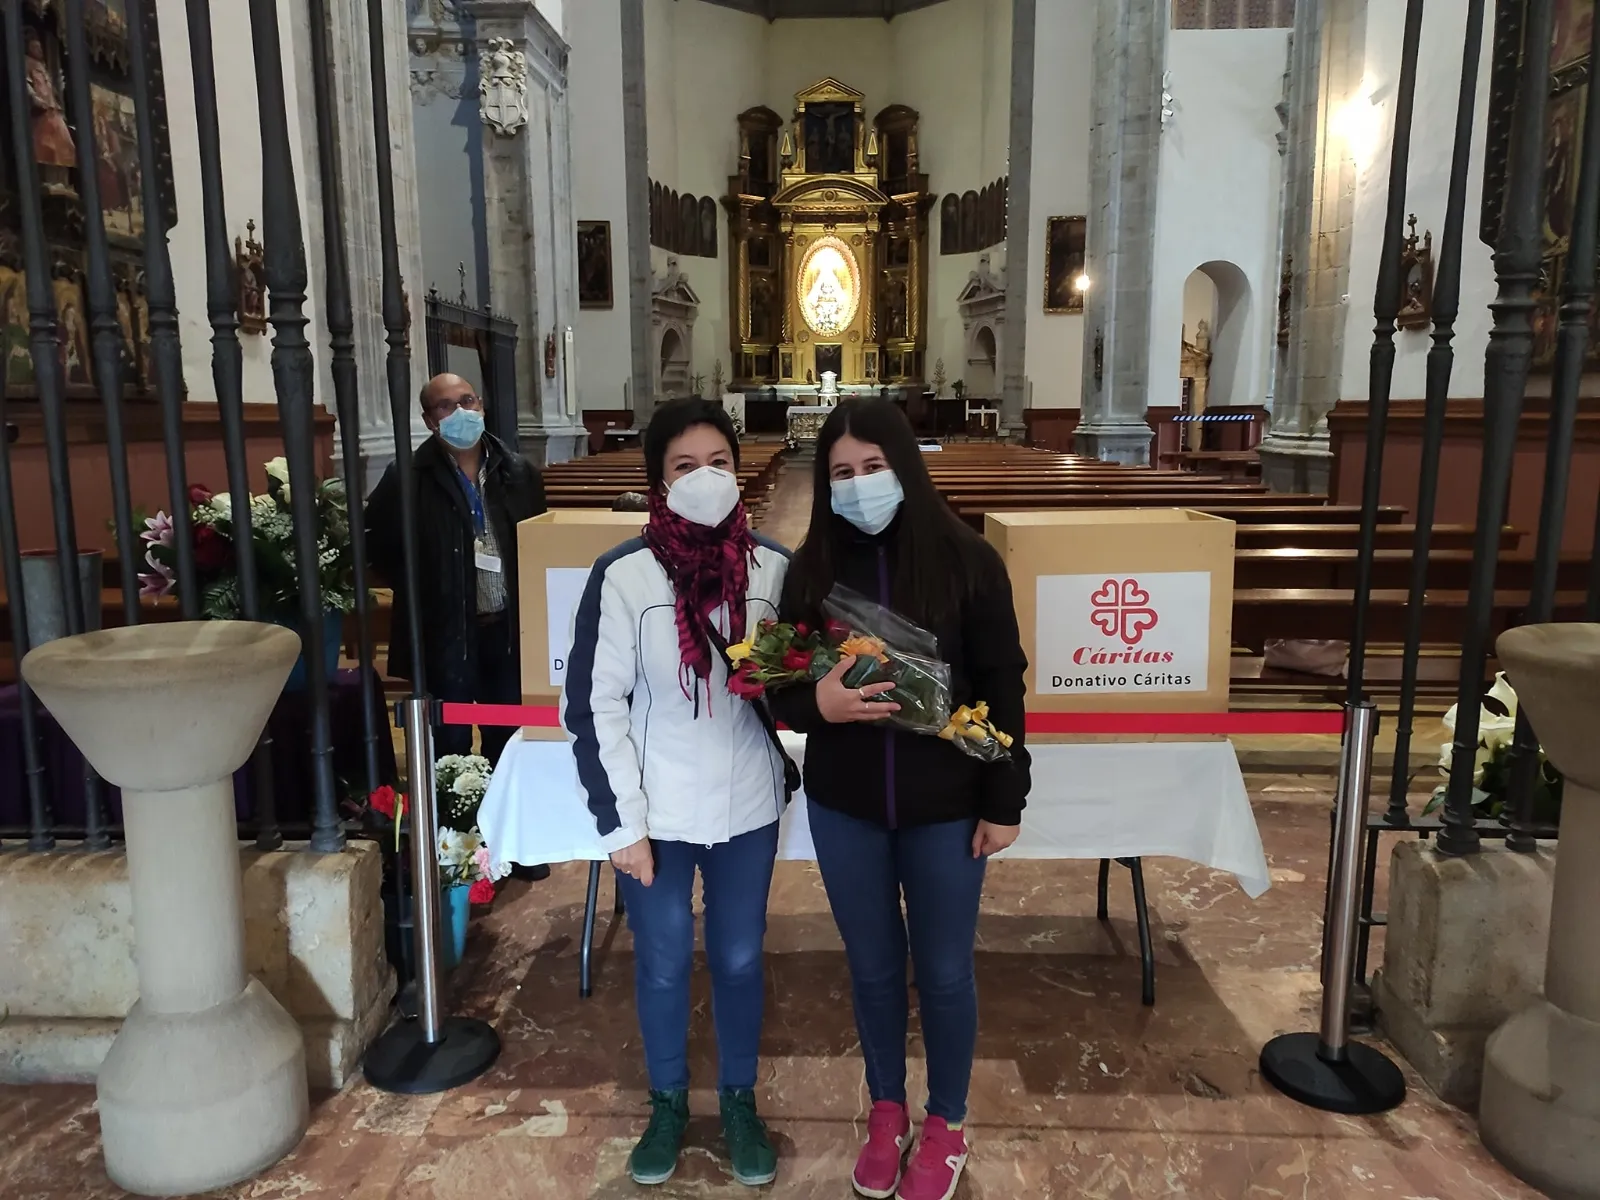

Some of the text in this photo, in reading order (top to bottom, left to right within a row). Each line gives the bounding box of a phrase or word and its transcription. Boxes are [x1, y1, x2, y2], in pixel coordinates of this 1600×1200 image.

[1072, 646, 1175, 666] Cáritas
[1052, 673, 1192, 688] Donativo Cáritas
